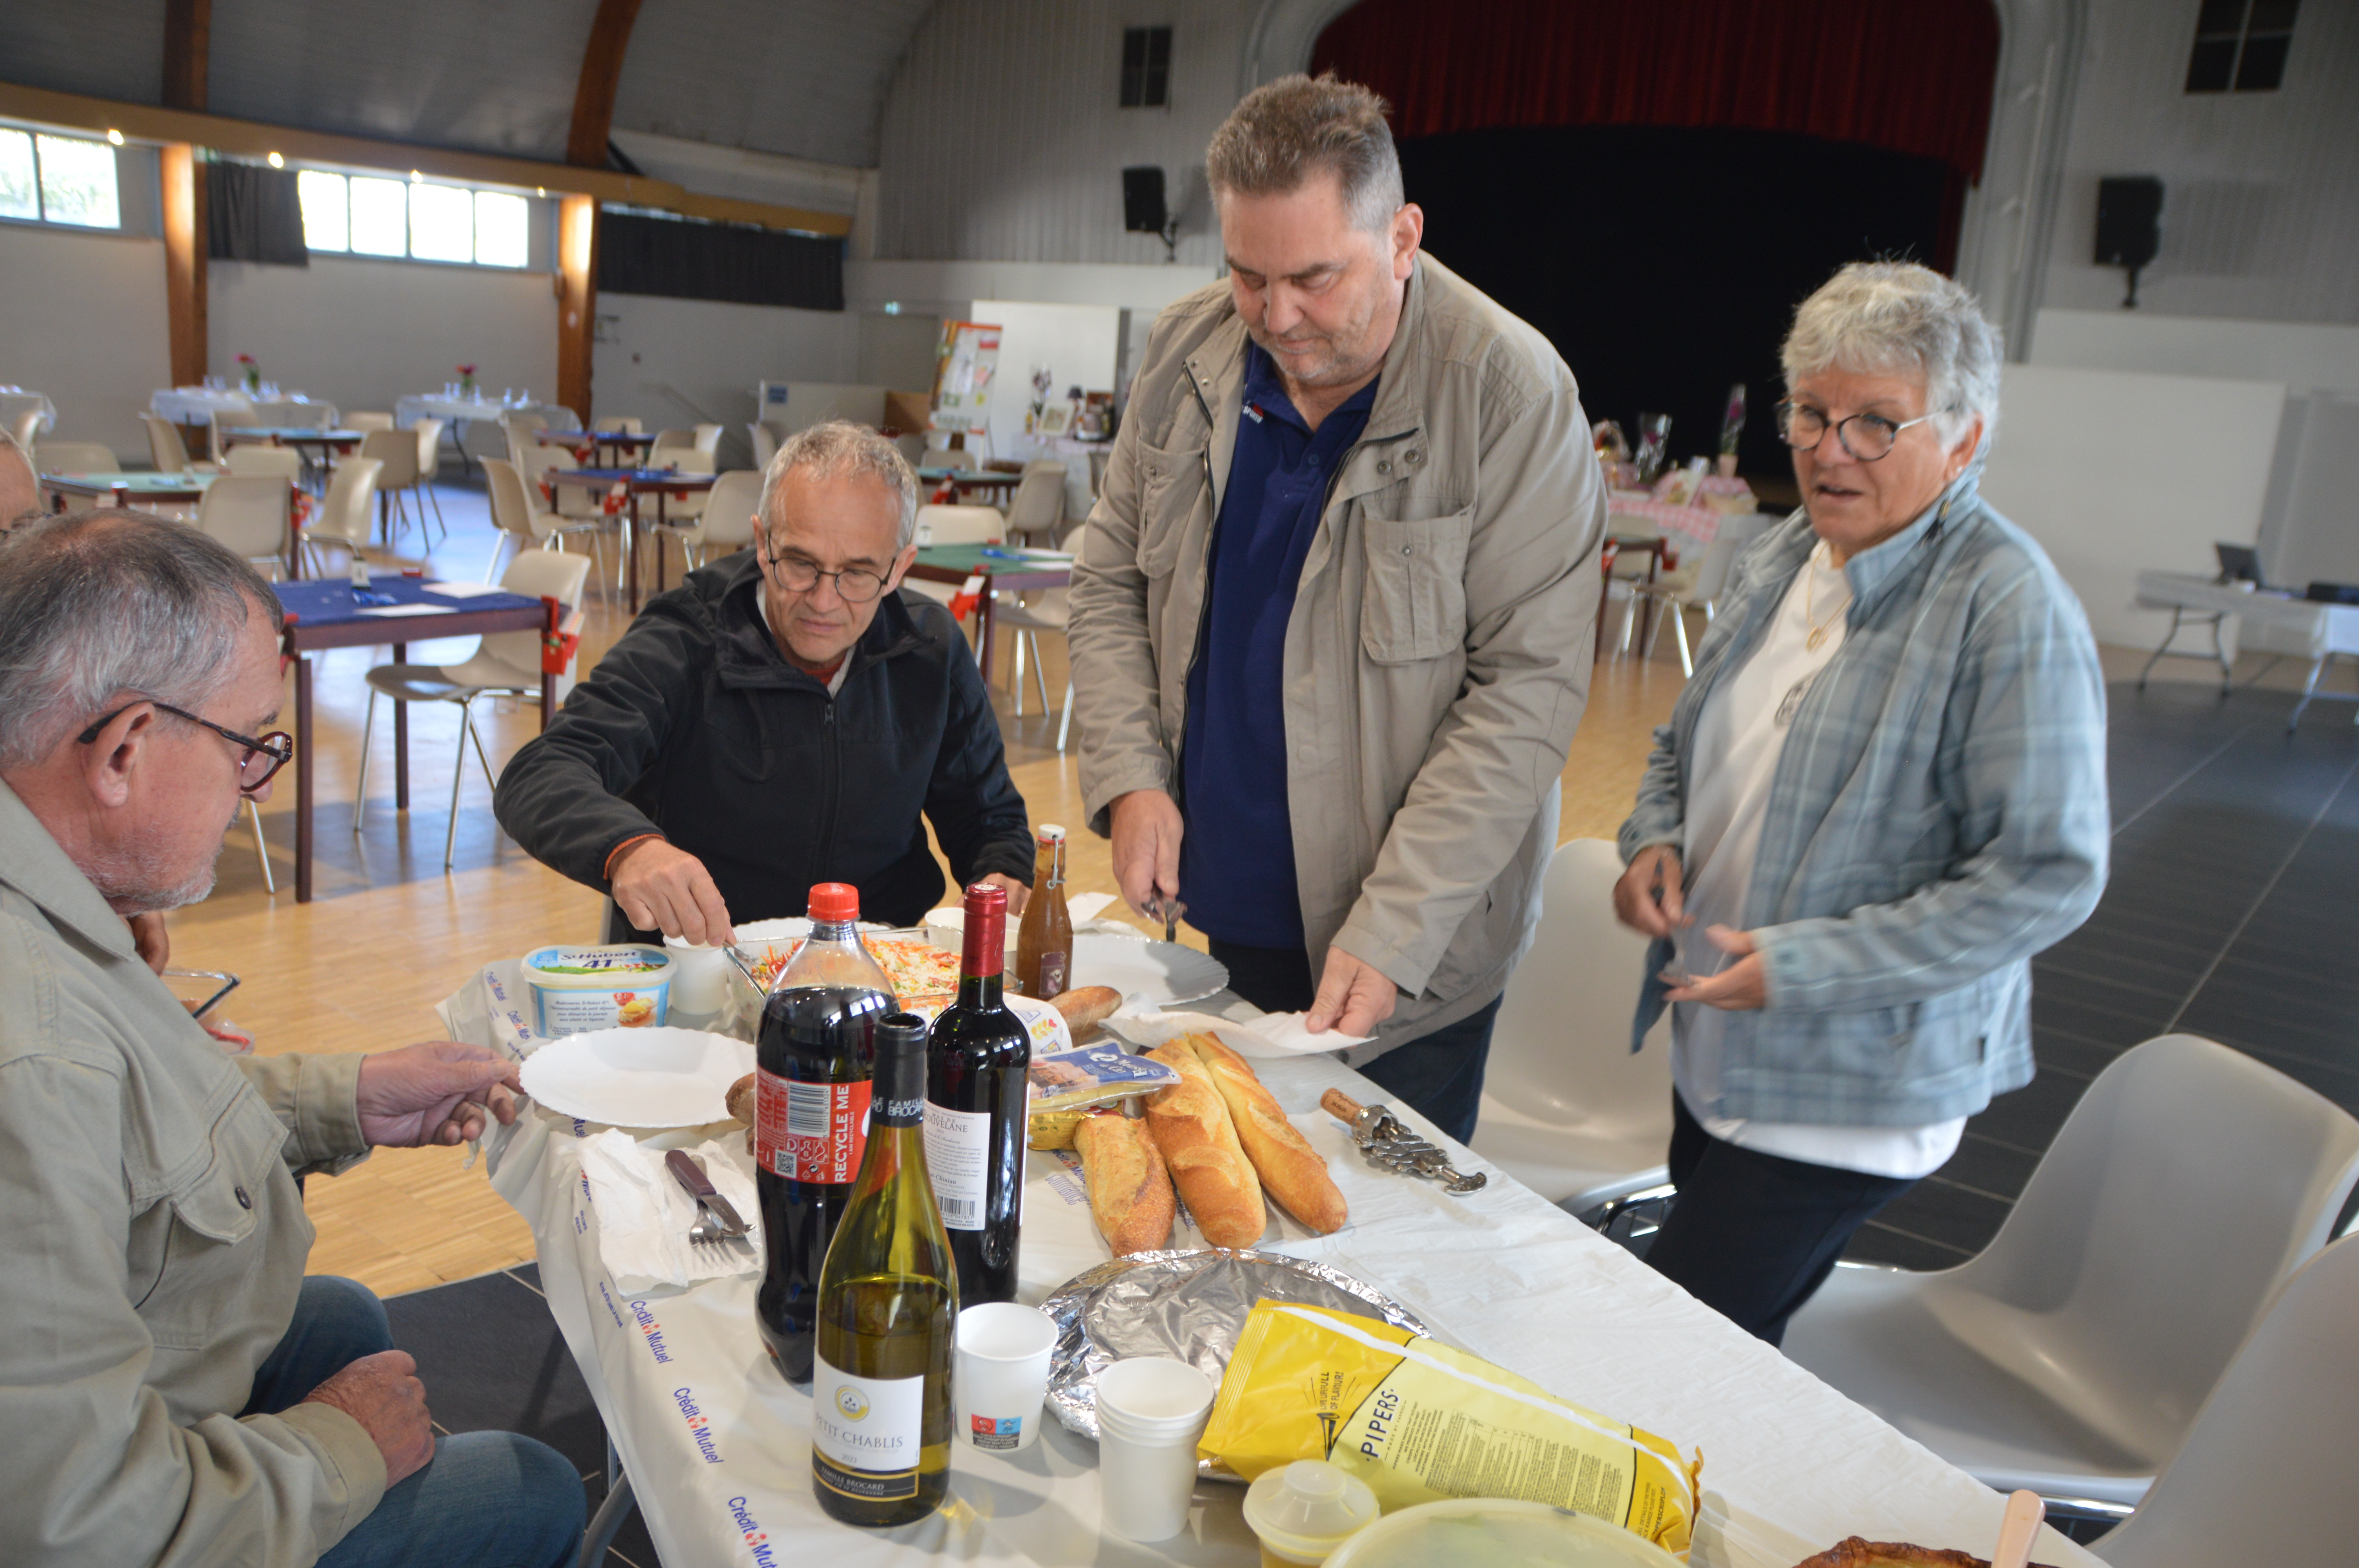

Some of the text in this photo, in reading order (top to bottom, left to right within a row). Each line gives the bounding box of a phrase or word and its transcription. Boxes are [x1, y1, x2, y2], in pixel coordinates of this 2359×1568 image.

[1242, 405, 1263, 424] SPORTIF
[582, 960, 612, 969] 41
[834, 1085, 849, 1182] RECYCLE ME
[646, 1331, 673, 1363] Mutuel
[1330, 1402, 1338, 1410] OF
[674, 1388, 723, 1464] Crédit Mutuel
[1360, 1390, 1399, 1459] PIPERS
[843, 1431, 903, 1448] CHABLIS
[1387, 1434, 1395, 1450] MADE
[1406, 1427, 1415, 1445] PRODUCE
[1412, 1443, 1422, 1462] LOCALLY
[1418, 1427, 1427, 1443] SOURCED
[1428, 1432, 1437, 1450] CREATING
[841, 1453, 857, 1463] 2023
[1392, 1453, 1400, 1470] PIPERS
[1405, 1448, 1414, 1464] CRISPS
[1414, 1449, 1425, 1473] WORKING
[847, 1477, 884, 1490] BROCARD
[728, 1496, 759, 1534] Crédit
